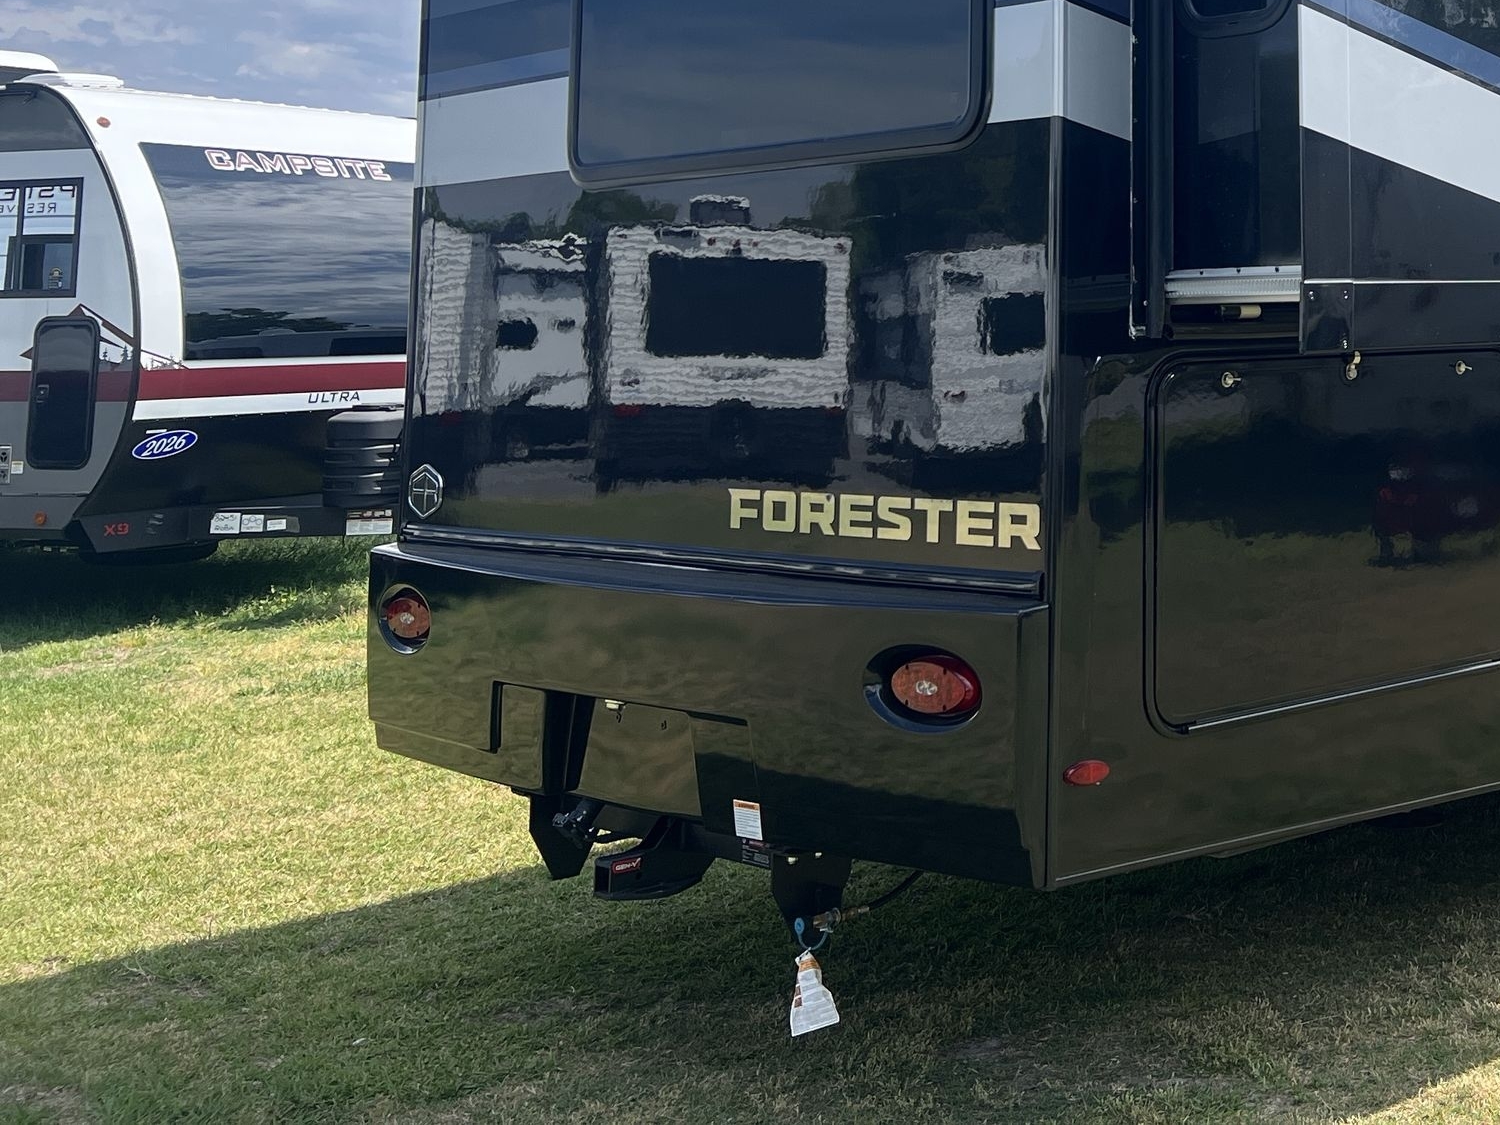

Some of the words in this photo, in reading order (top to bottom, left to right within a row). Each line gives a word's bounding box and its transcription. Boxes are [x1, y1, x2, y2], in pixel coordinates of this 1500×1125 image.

[204, 149, 393, 181] CAMPSITE
[308, 391, 360, 404] ULTRA
[141, 433, 190, 457] 2026
[728, 488, 1042, 551] FORESTER
